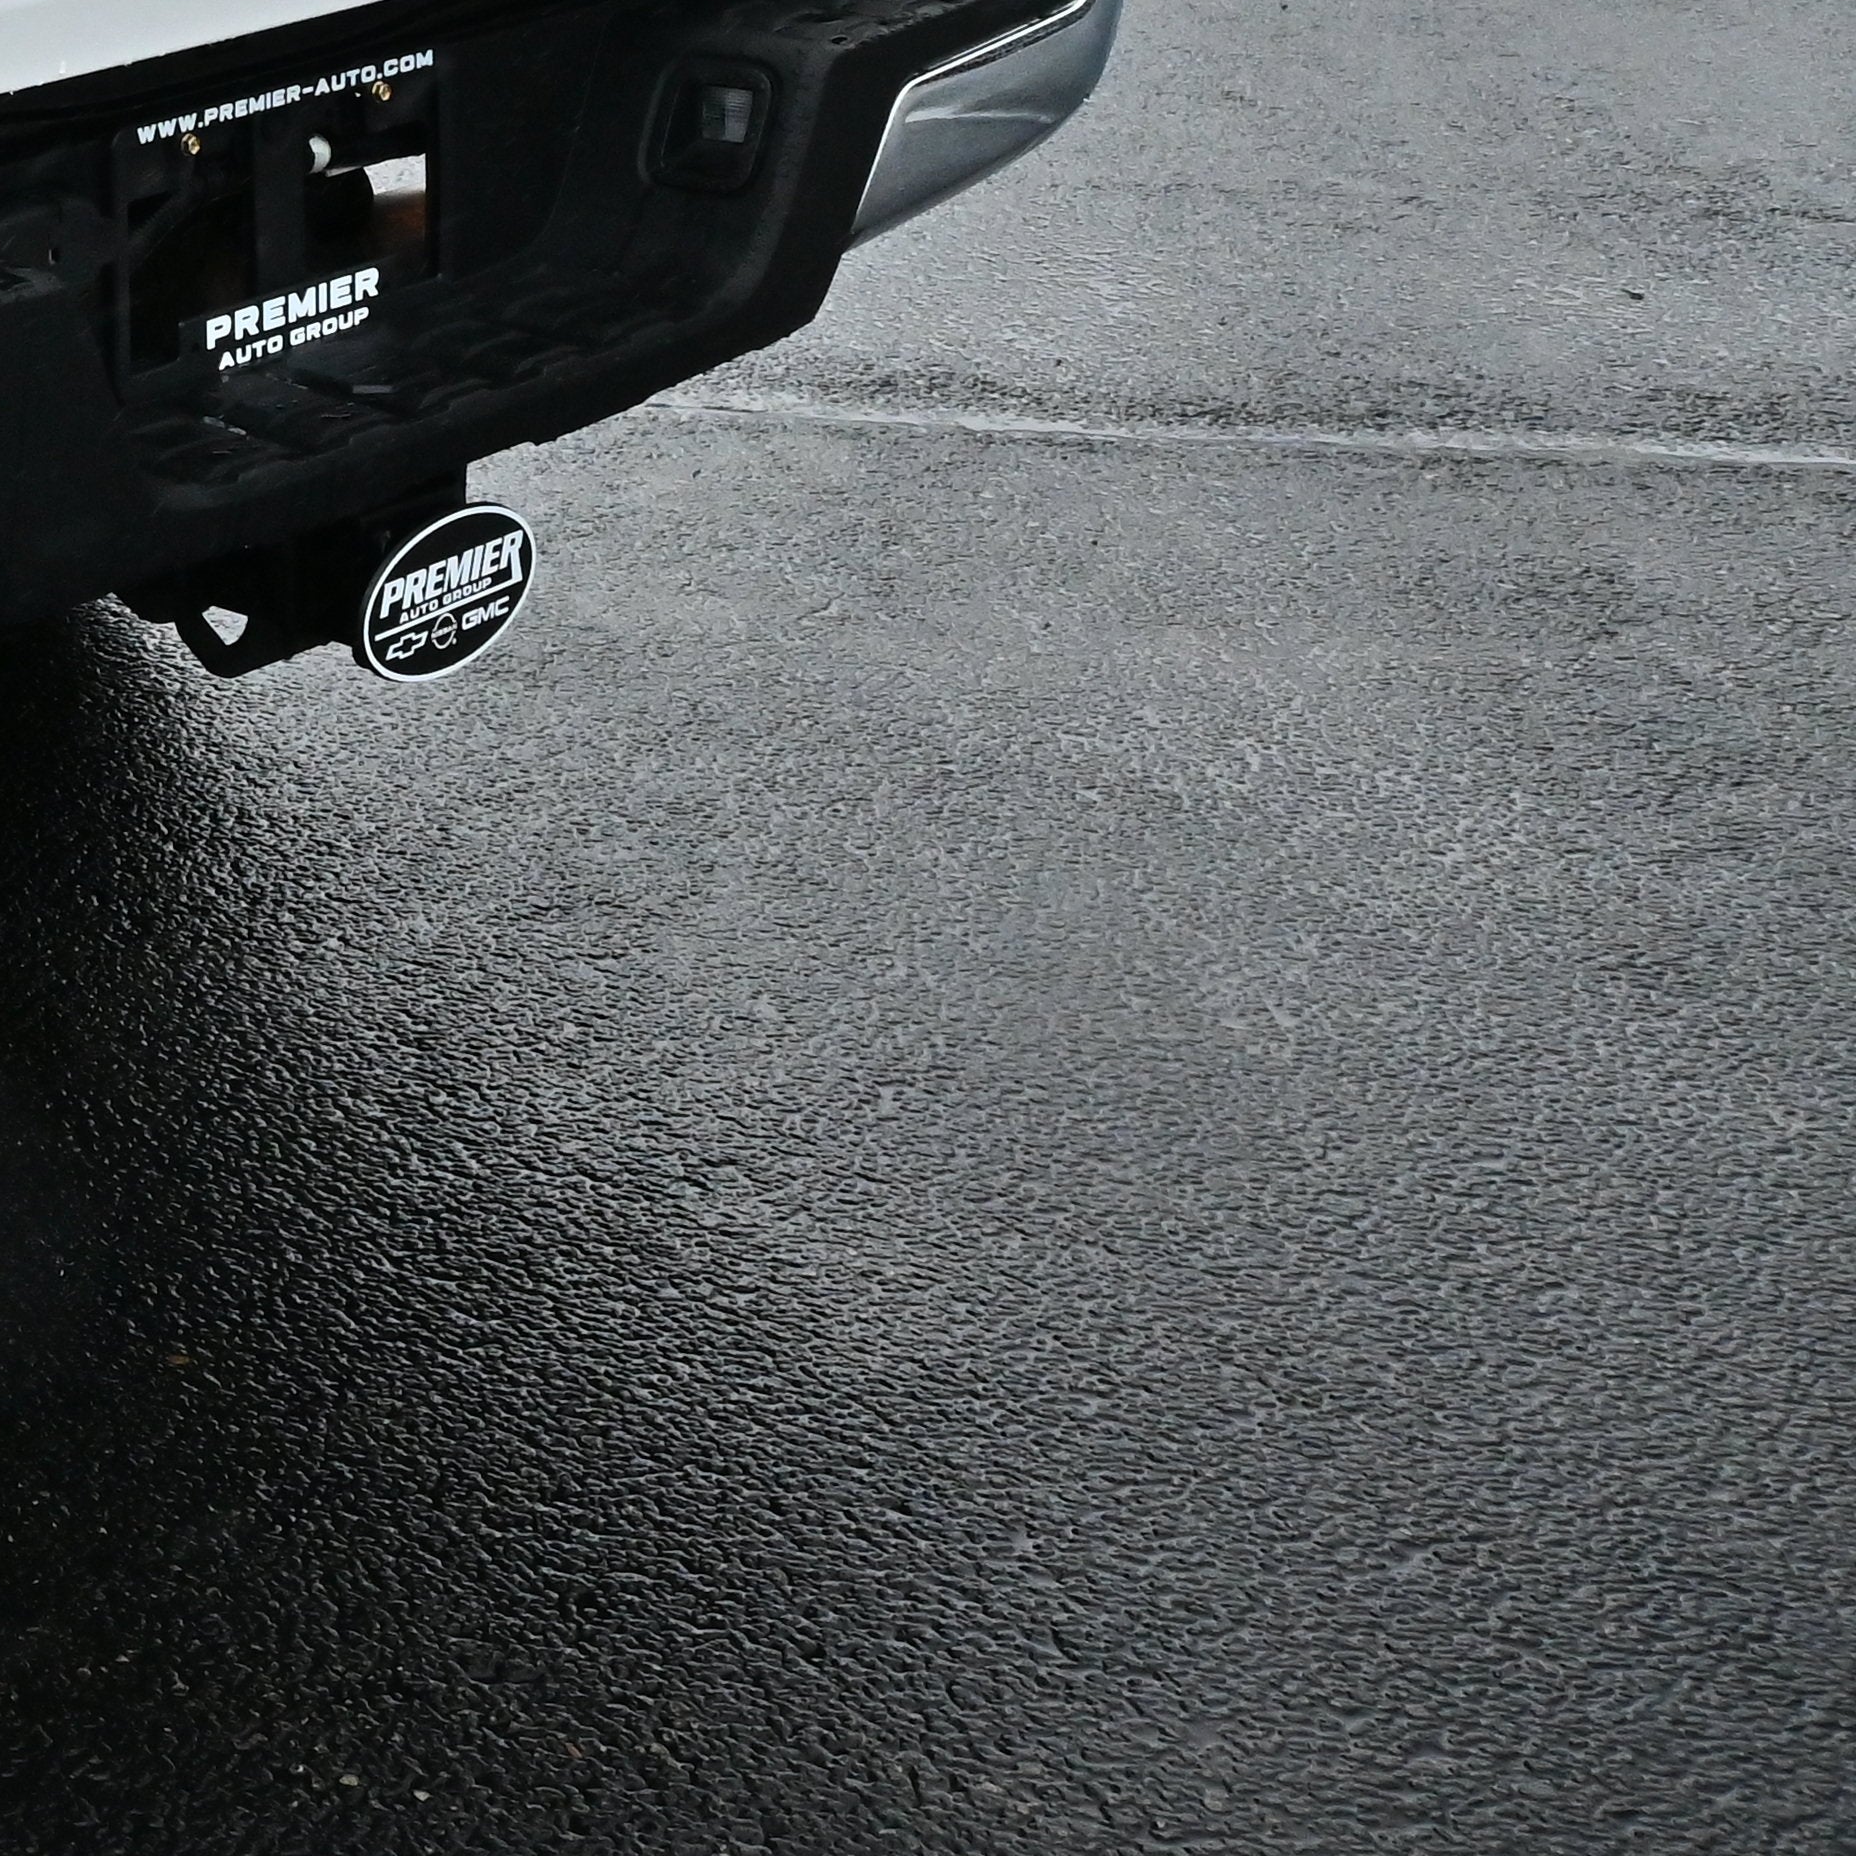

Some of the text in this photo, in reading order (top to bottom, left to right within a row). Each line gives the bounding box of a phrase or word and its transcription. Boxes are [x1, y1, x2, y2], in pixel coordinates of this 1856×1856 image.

[137, 49, 434, 145] WWW.PREMIER-AUTO.COM
[205, 267, 380, 350] PREMIER
[218, 307, 370, 371] AUTO GROUP
[379, 529, 524, 620] PREMIER
[399, 577, 492, 624] AUTO GROUP
[461, 596, 510, 630] GMC
